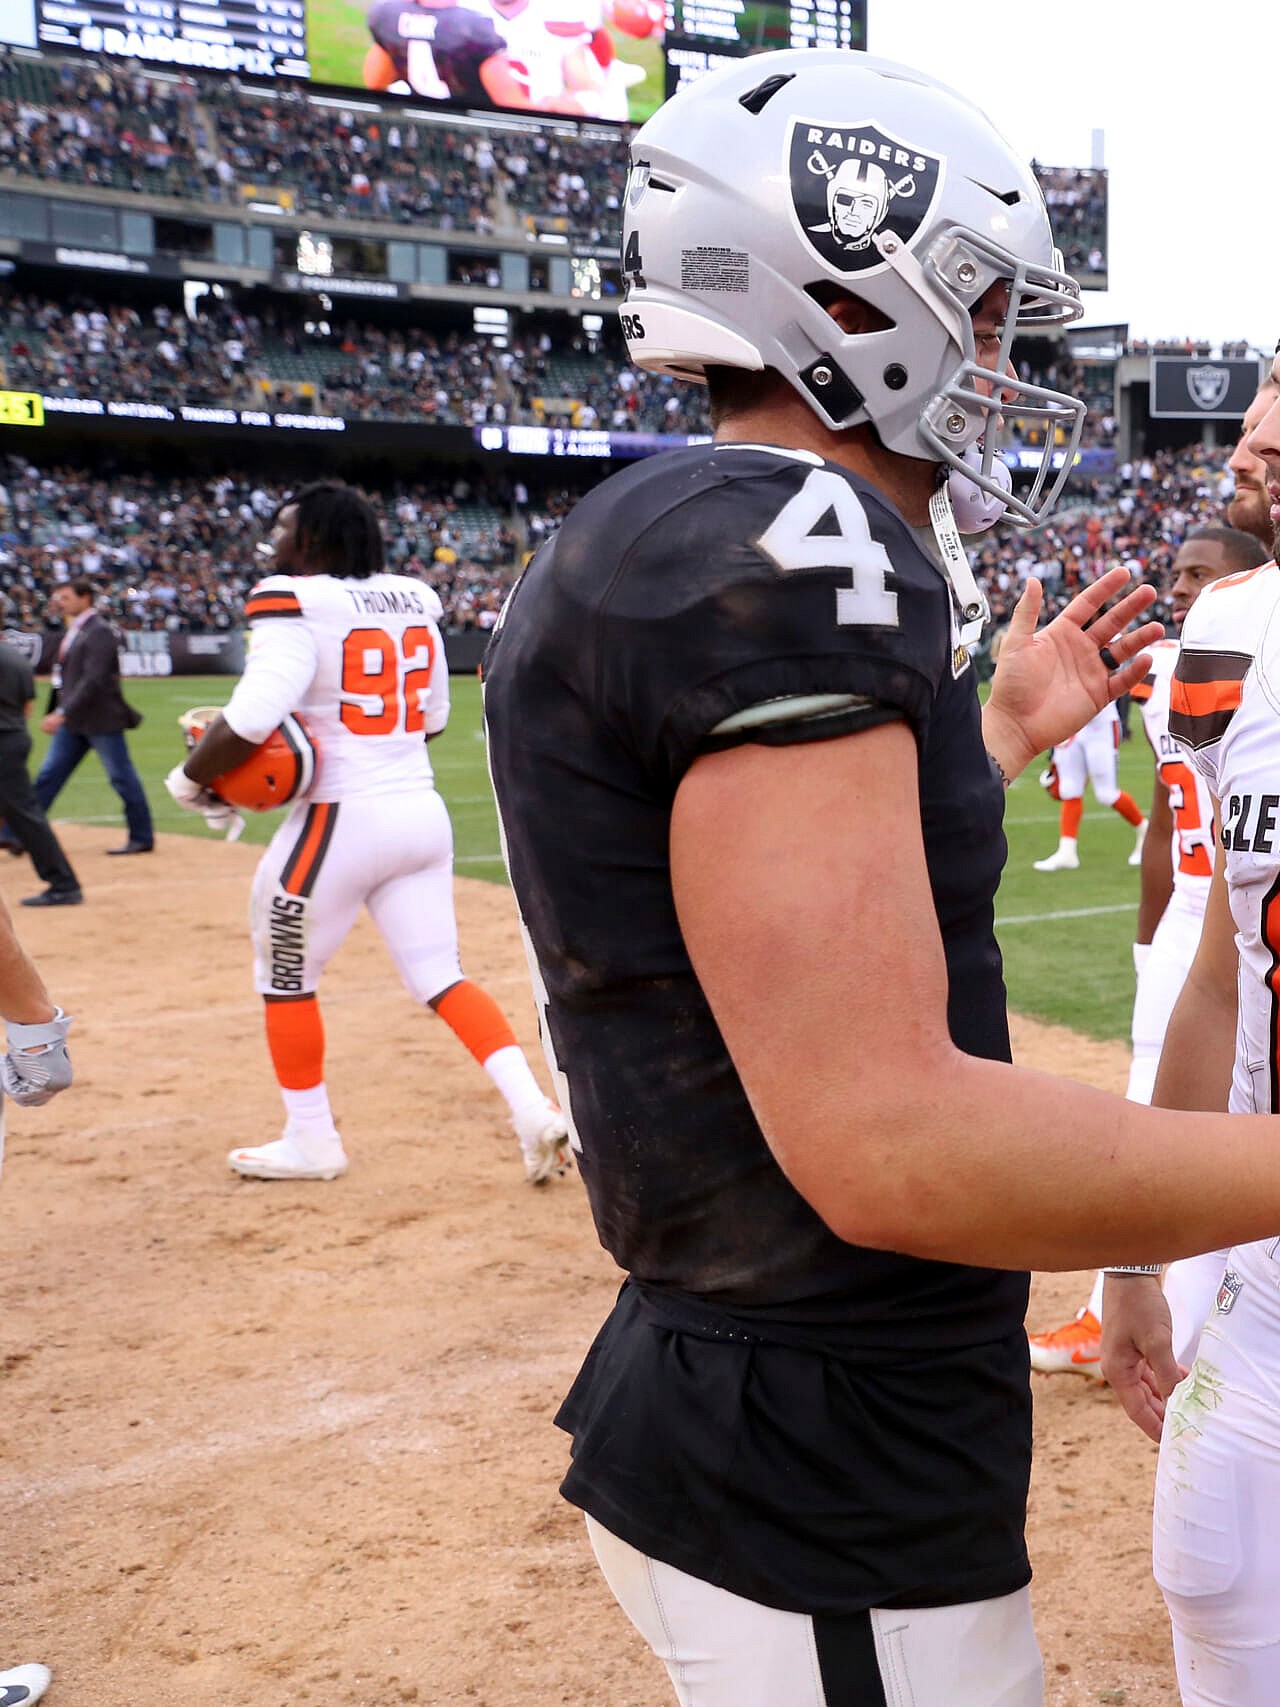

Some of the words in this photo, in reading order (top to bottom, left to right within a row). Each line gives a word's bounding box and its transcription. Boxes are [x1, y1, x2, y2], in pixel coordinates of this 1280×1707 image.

[807, 127, 926, 172] RAIDERS
[755, 466, 900, 627] 4
[344, 589, 424, 614] THOMAS
[338, 625, 436, 736] 92
[270, 896, 304, 991] BROWNS
